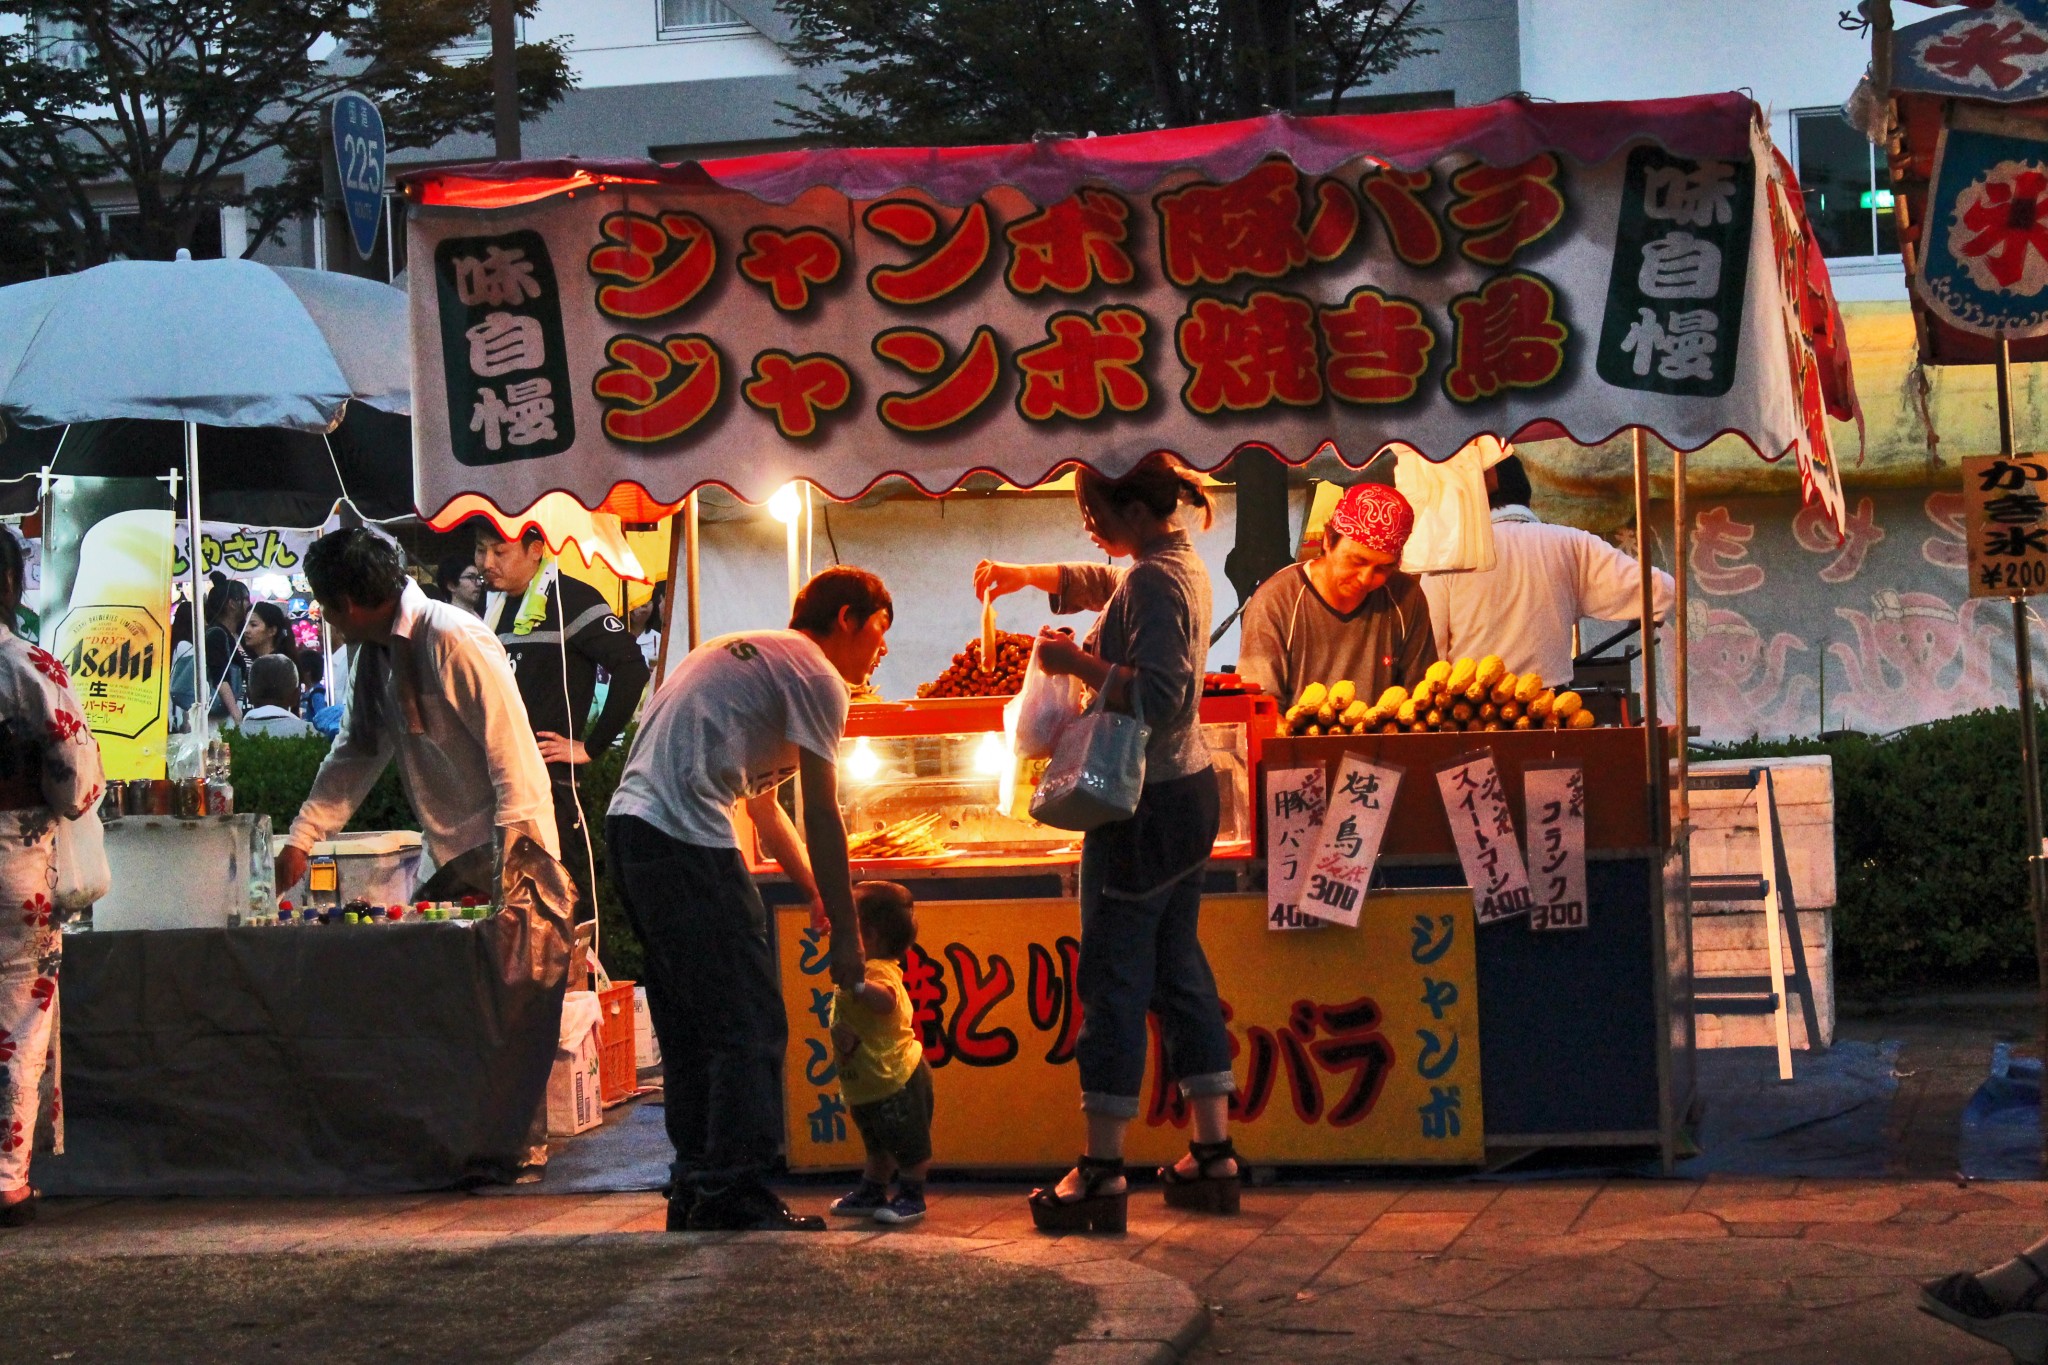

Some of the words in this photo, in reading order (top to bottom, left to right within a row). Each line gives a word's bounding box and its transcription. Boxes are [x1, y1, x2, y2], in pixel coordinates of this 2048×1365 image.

[344, 133, 380, 194] 225
[587, 152, 1565, 320] ジャンボ豚バラ
[1620, 157, 1737, 381] 味自慢
[451, 244, 559, 451] 味自慢
[592, 269, 1569, 445] ジャンボ焼き鳥
[1980, 560, 2046, 589] ¥200
[62, 638, 153, 682] Asahi
[89, 680, 107, 697] 生
[1452, 767, 1510, 895] スイートコーン
[1541, 801, 1568, 903] フランク
[1307, 873, 1360, 911] 300
[1480, 886, 1530, 918] 400
[1532, 901, 1582, 929] 300
[1411, 915, 1461, 1138] ジャンボ
